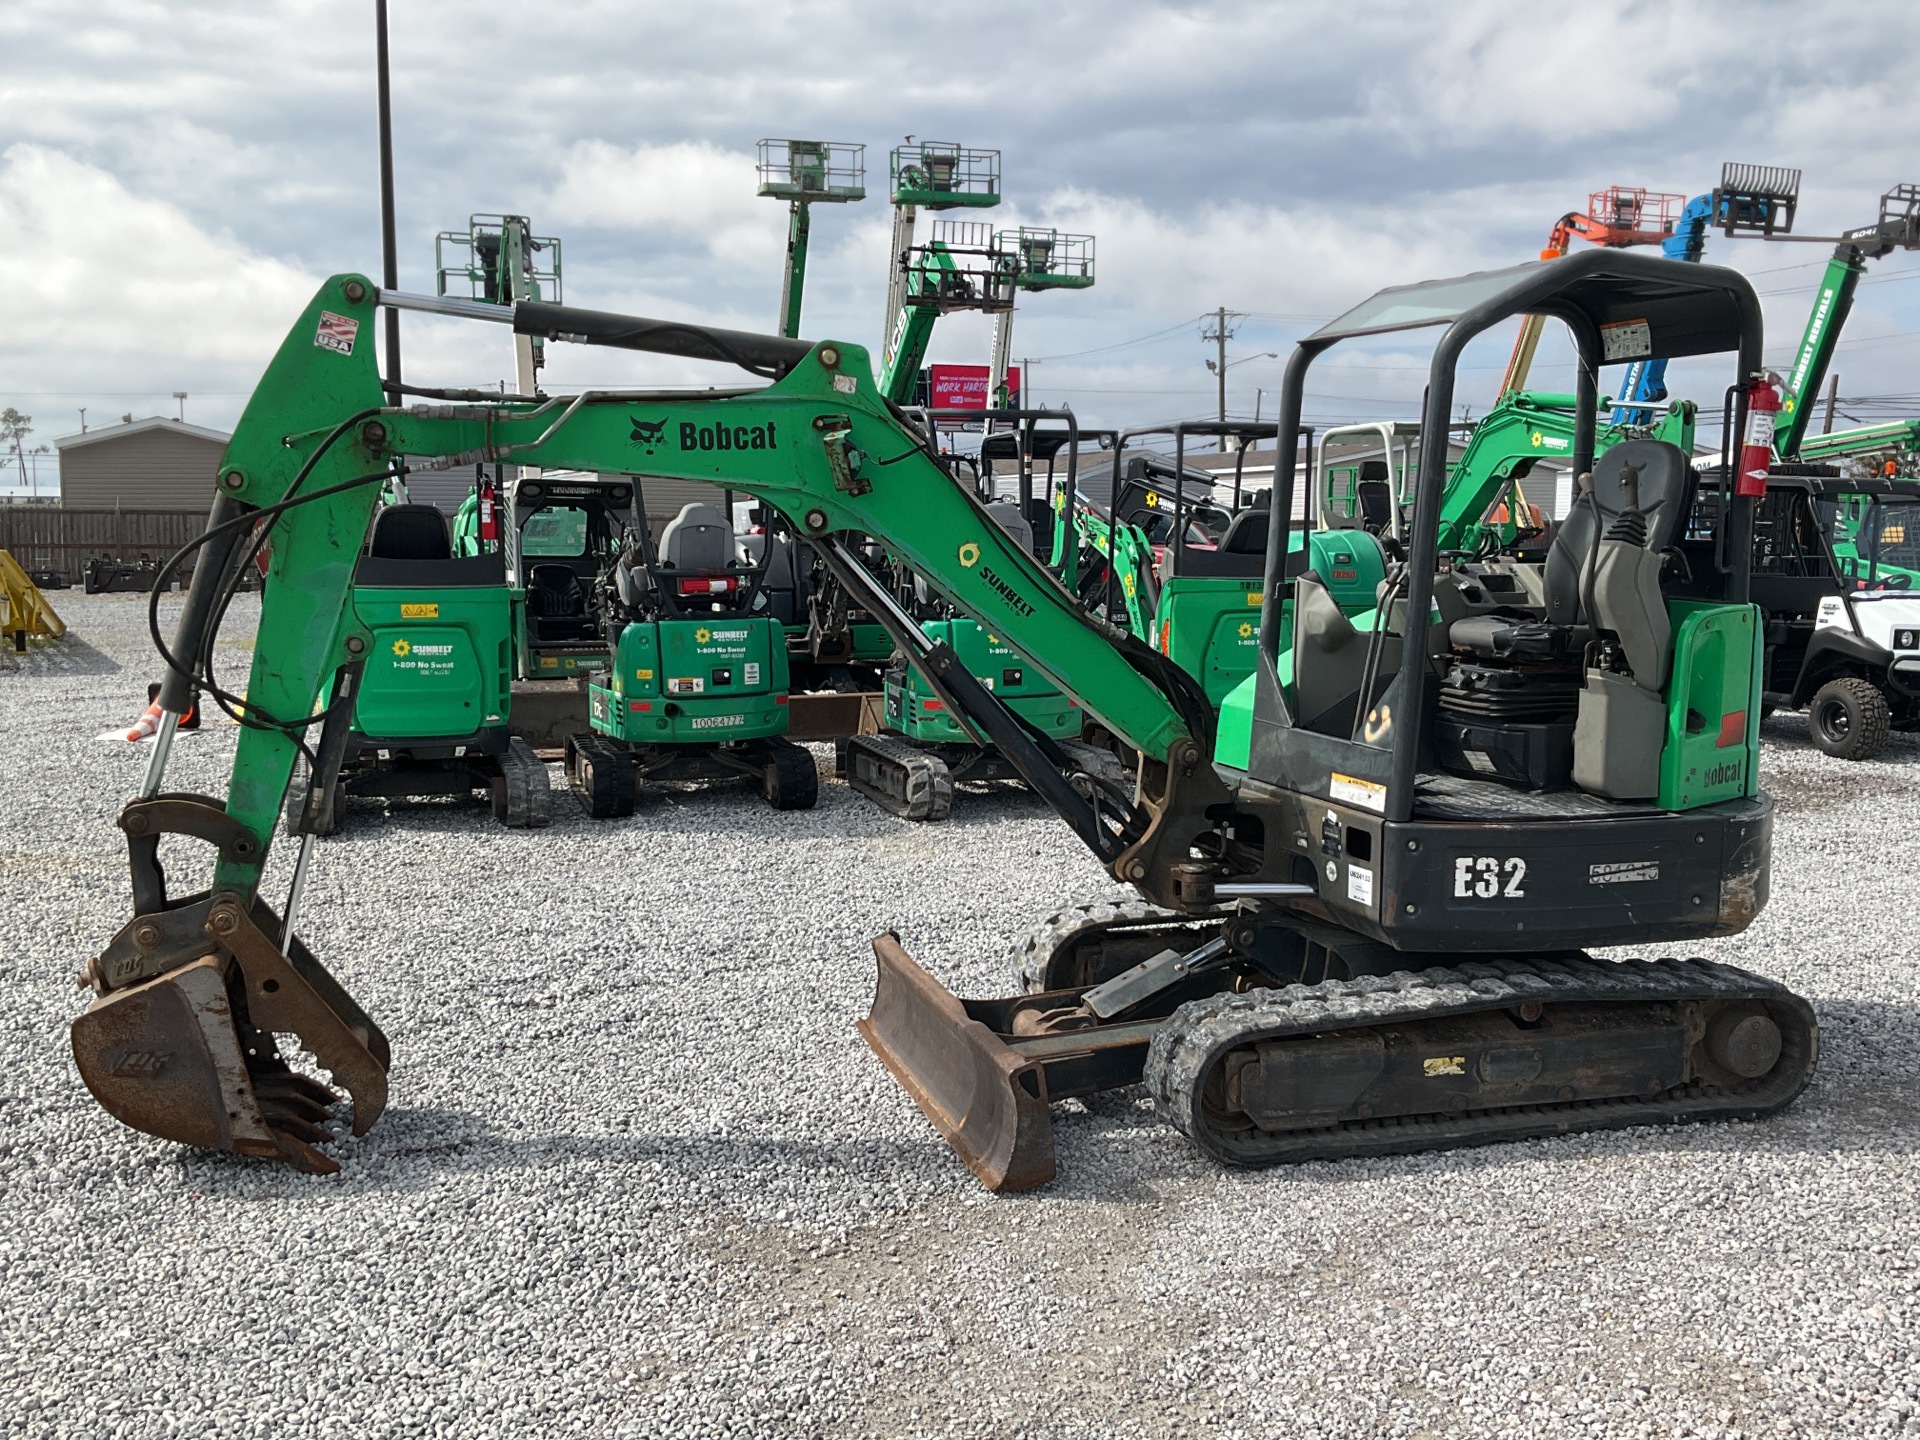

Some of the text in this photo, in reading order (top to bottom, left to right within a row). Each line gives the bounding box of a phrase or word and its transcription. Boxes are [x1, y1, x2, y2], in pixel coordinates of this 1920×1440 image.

[1808, 288, 1833, 344] RENTALS
[317, 334, 350, 351] USA
[888, 307, 908, 370] JCB
[936, 382, 989, 393] WORK HARDE
[679, 421, 778, 451] Bobcat
[979, 566, 1037, 618] SUNBELT
[412, 645, 453, 653] SUNBELT
[712, 630, 748, 639] SUNBELT
[1454, 857, 1527, 898] E32
